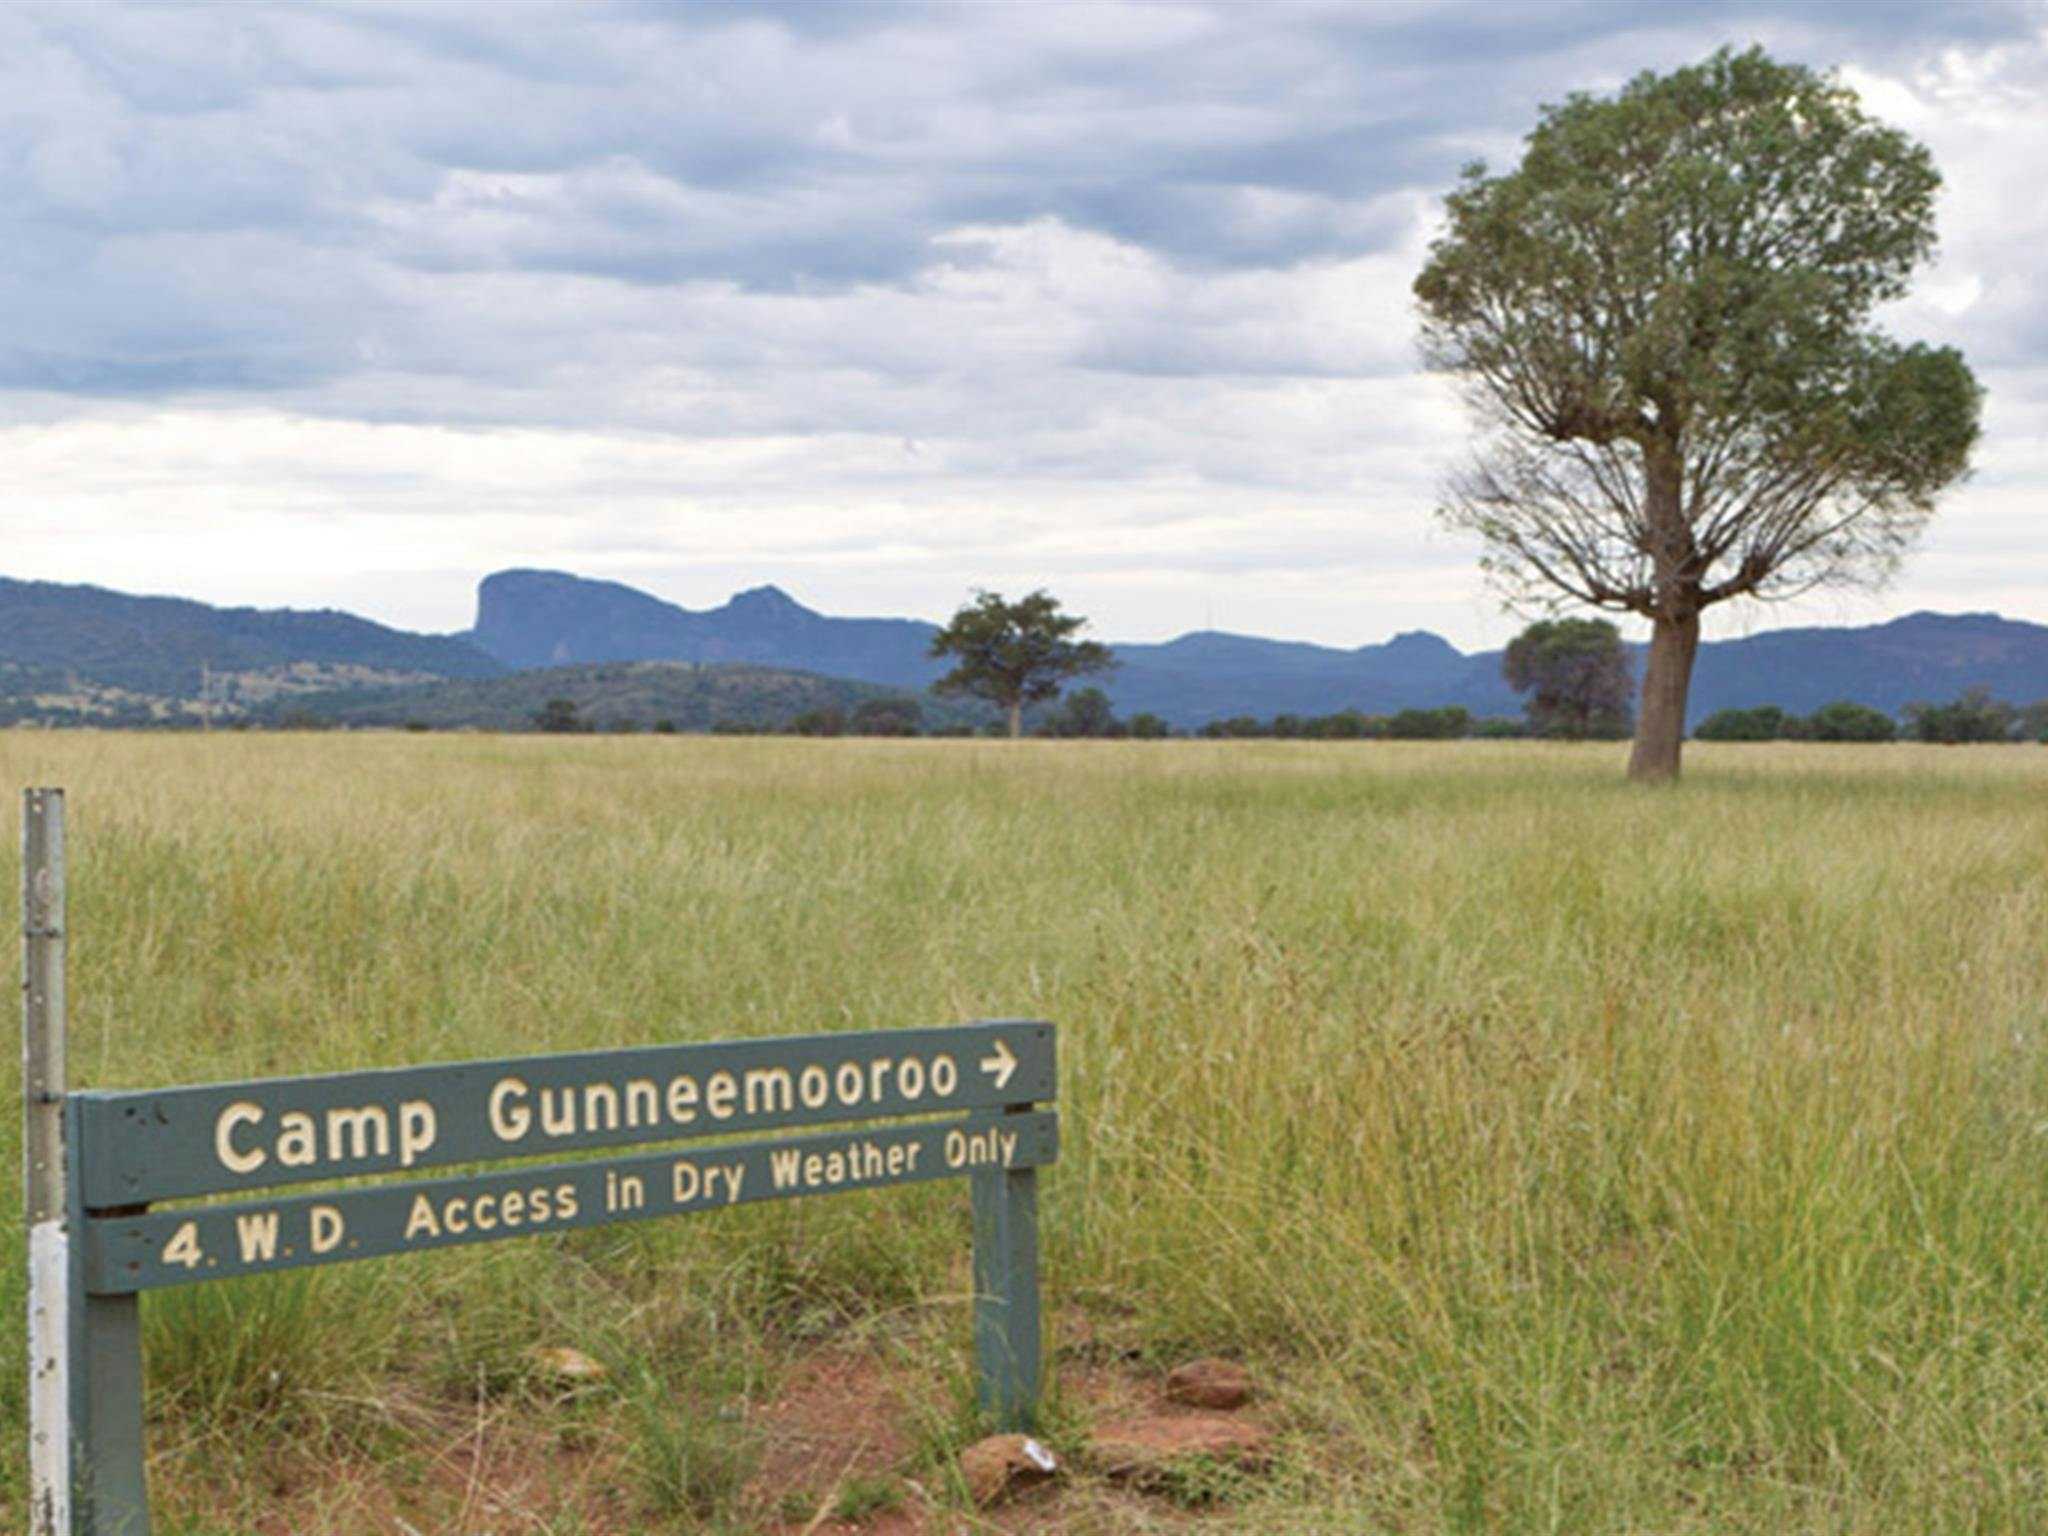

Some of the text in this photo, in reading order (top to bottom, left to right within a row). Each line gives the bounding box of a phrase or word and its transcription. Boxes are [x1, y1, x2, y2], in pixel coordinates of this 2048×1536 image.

[214, 1053, 959, 1174] Camp Gunneemooroo
[404, 1183, 579, 1239] Access
[605, 1170, 645, 1212] in
[672, 1160, 745, 1204] Dry
[770, 1141, 924, 1189] Weather
[943, 1127, 1019, 1168] Only
